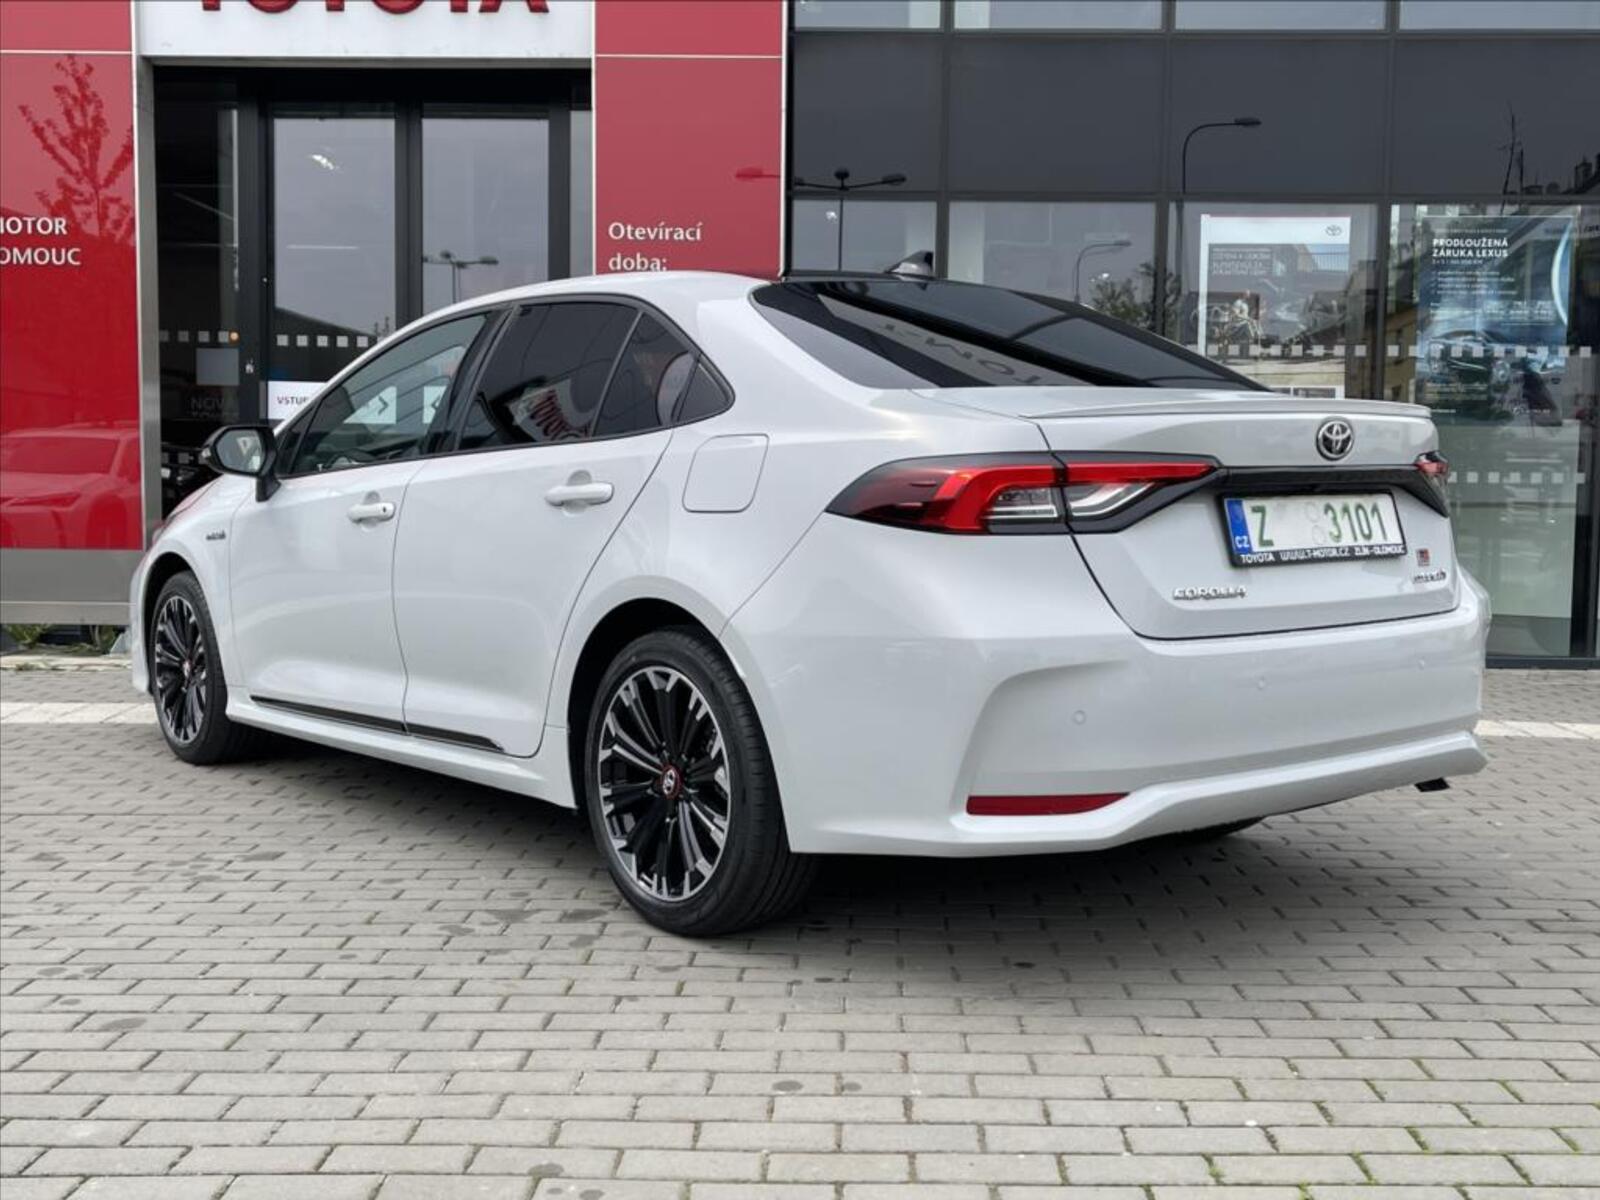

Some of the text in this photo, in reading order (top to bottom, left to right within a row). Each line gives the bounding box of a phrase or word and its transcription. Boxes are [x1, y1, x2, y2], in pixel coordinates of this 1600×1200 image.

[0, 216, 67, 235] OTOR
[608, 221, 703, 241] Otevírací
[1432, 237, 1508, 247] PRODLOUŽENÁ
[1432, 248, 1508, 258] ZÁRUKA LEXUS
[608, 252, 667, 271] doba:
[1251, 502, 1388, 547] Z 3101
[1235, 535, 1250, 549] CZ
[1240, 551, 1276, 564] TOYOTA
[1173, 585, 1249, 600] COROLLA
